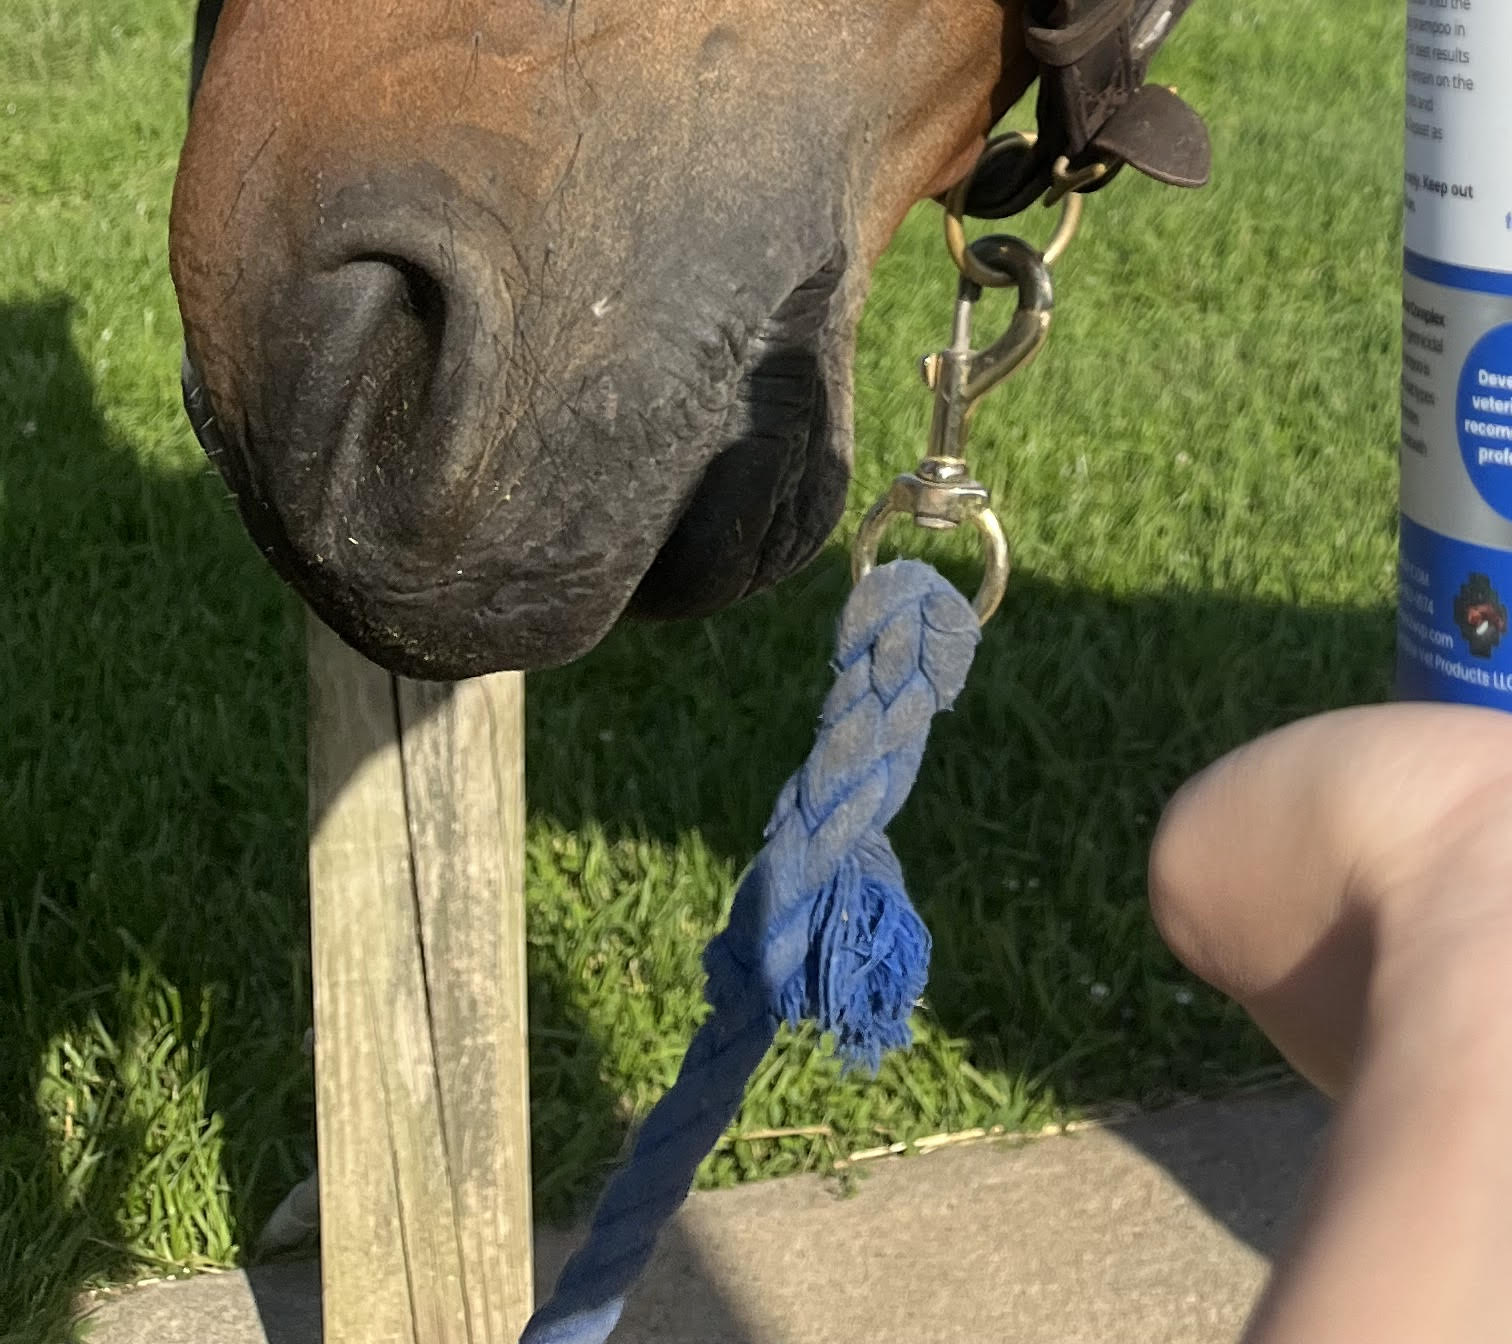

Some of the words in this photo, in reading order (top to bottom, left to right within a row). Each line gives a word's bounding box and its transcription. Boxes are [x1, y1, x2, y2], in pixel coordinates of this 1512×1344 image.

[1454, 20, 1466, 37] in
[1431, 46, 1470, 64] results
[1452, 73, 1474, 91] the
[1451, 182, 1474, 200] out
[1435, 654, 1490, 688] Products
